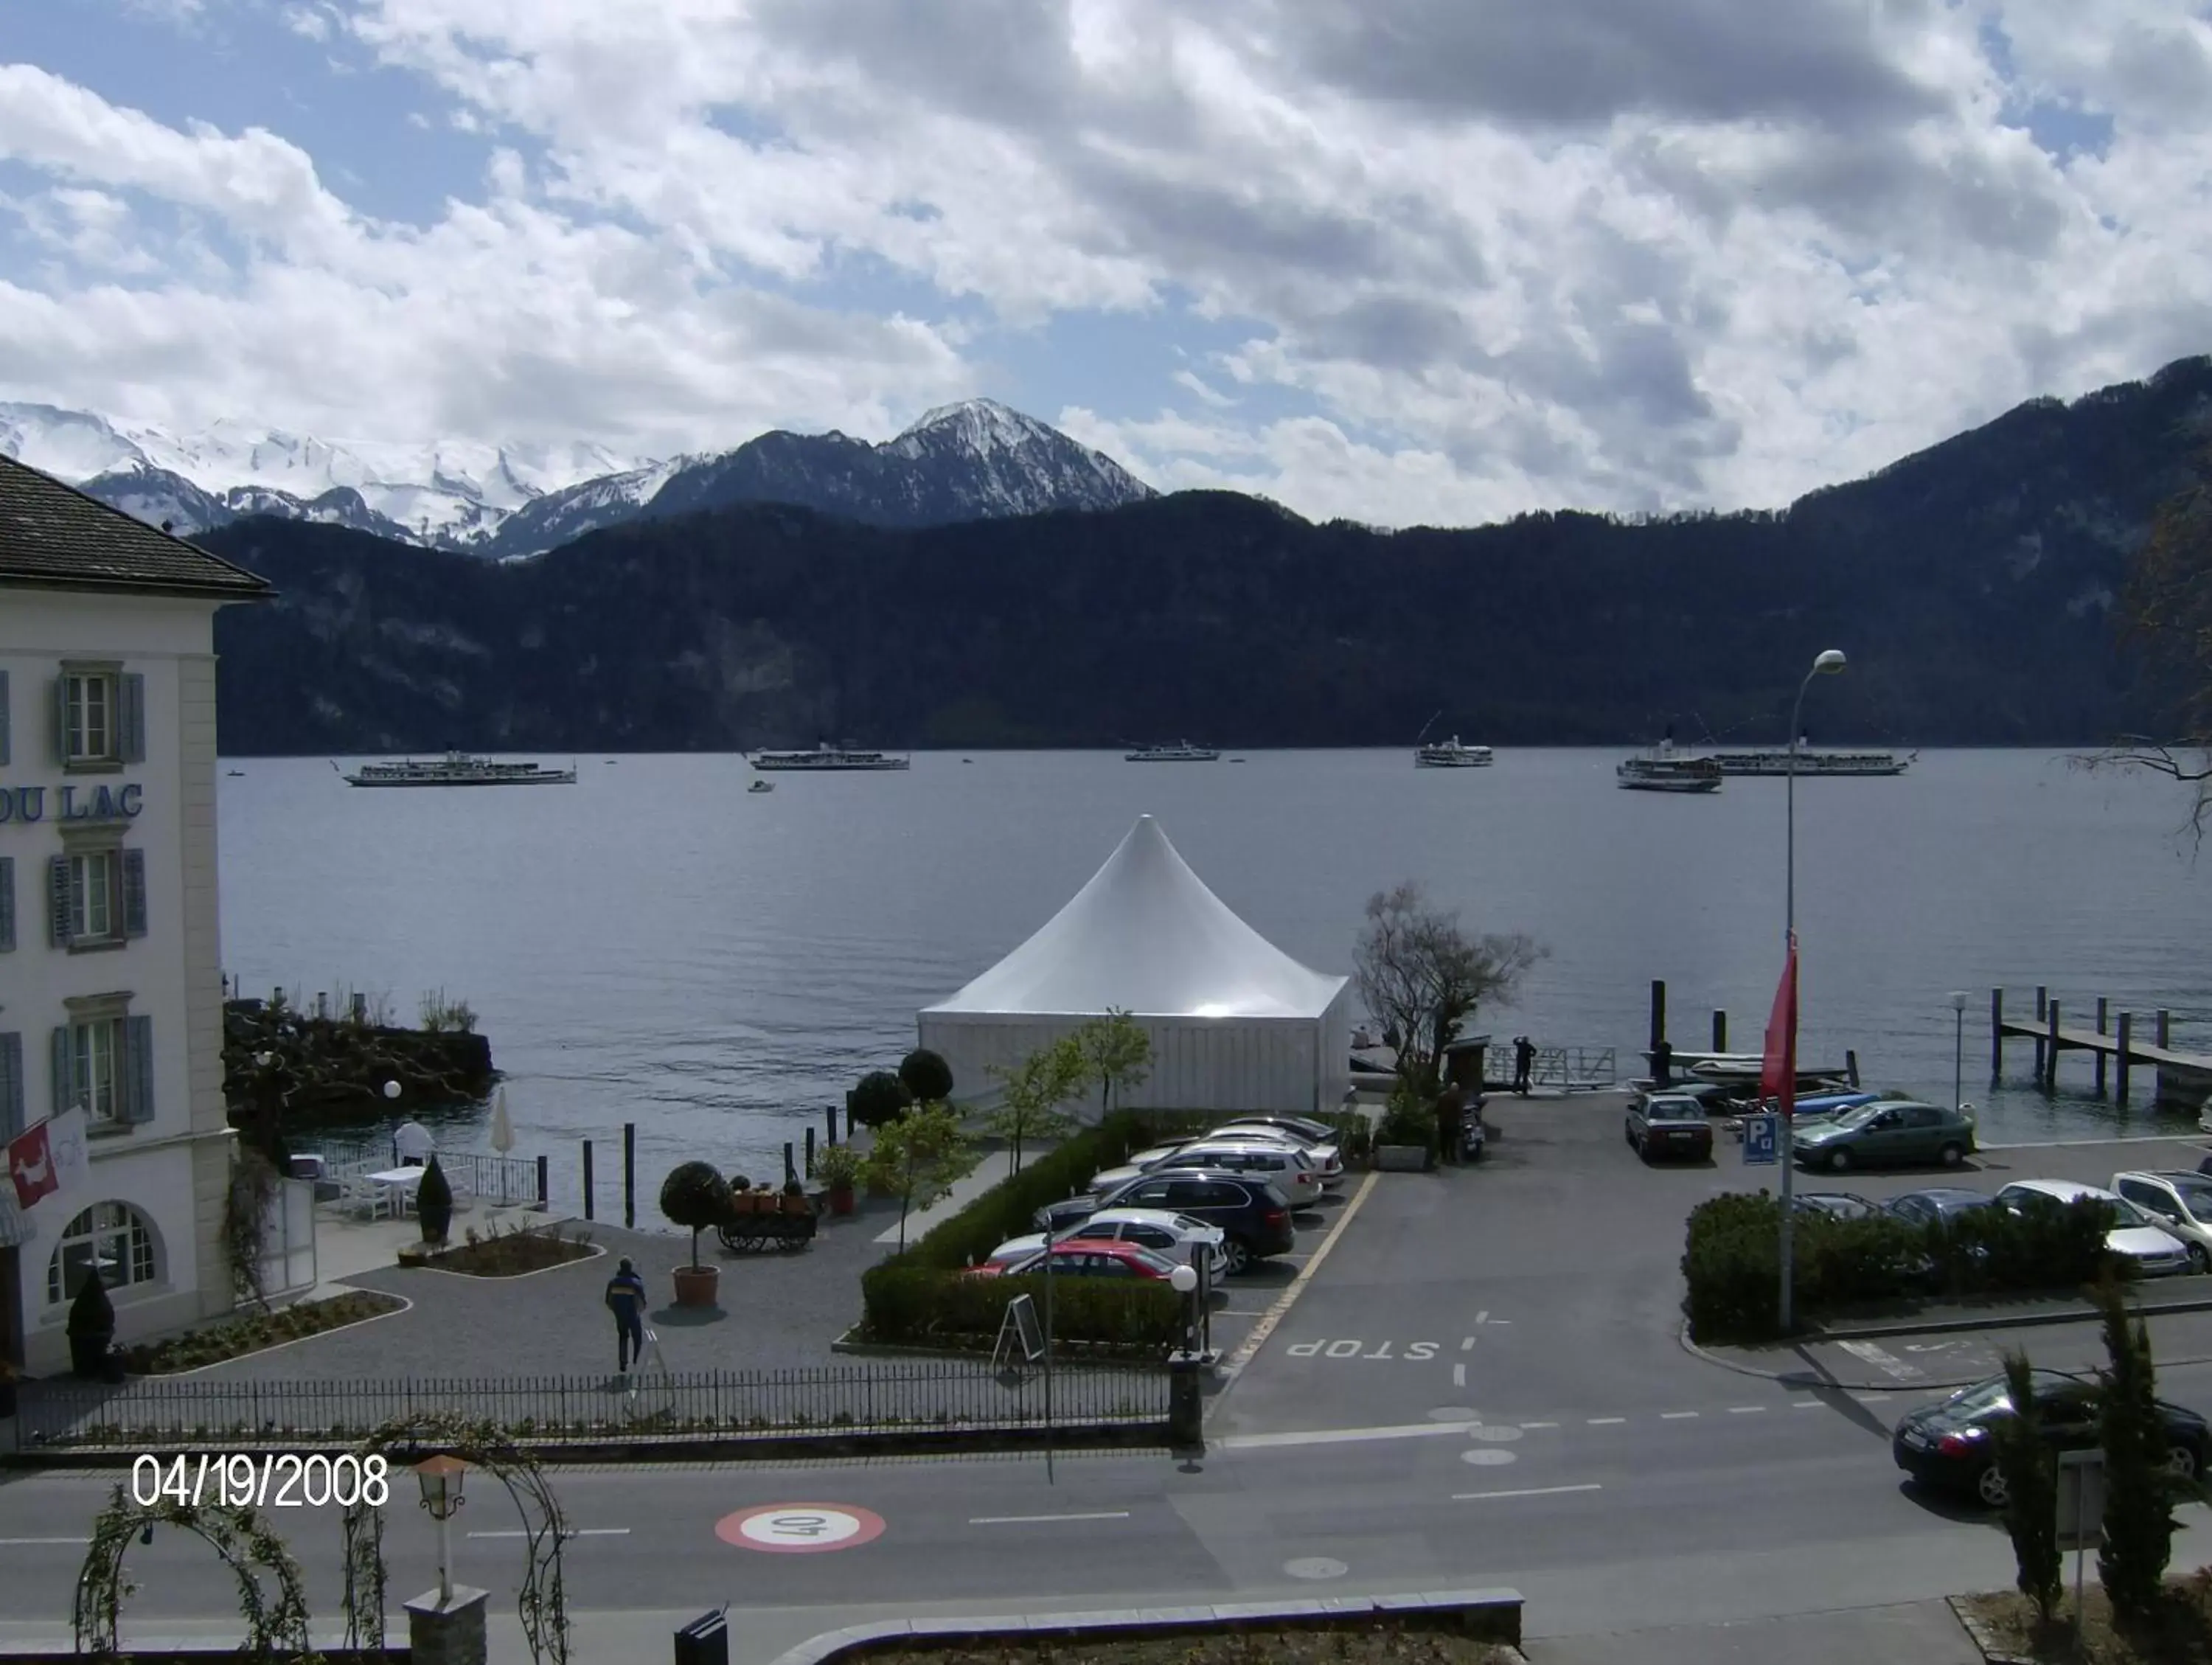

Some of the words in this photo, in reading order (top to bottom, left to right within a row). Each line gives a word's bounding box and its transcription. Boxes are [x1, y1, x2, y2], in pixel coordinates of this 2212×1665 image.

[62, 784, 143, 818] LAC
[1750, 1121, 1767, 1143] P
[1287, 1338, 1440, 1360] STOP
[771, 1517, 827, 1536] 40
